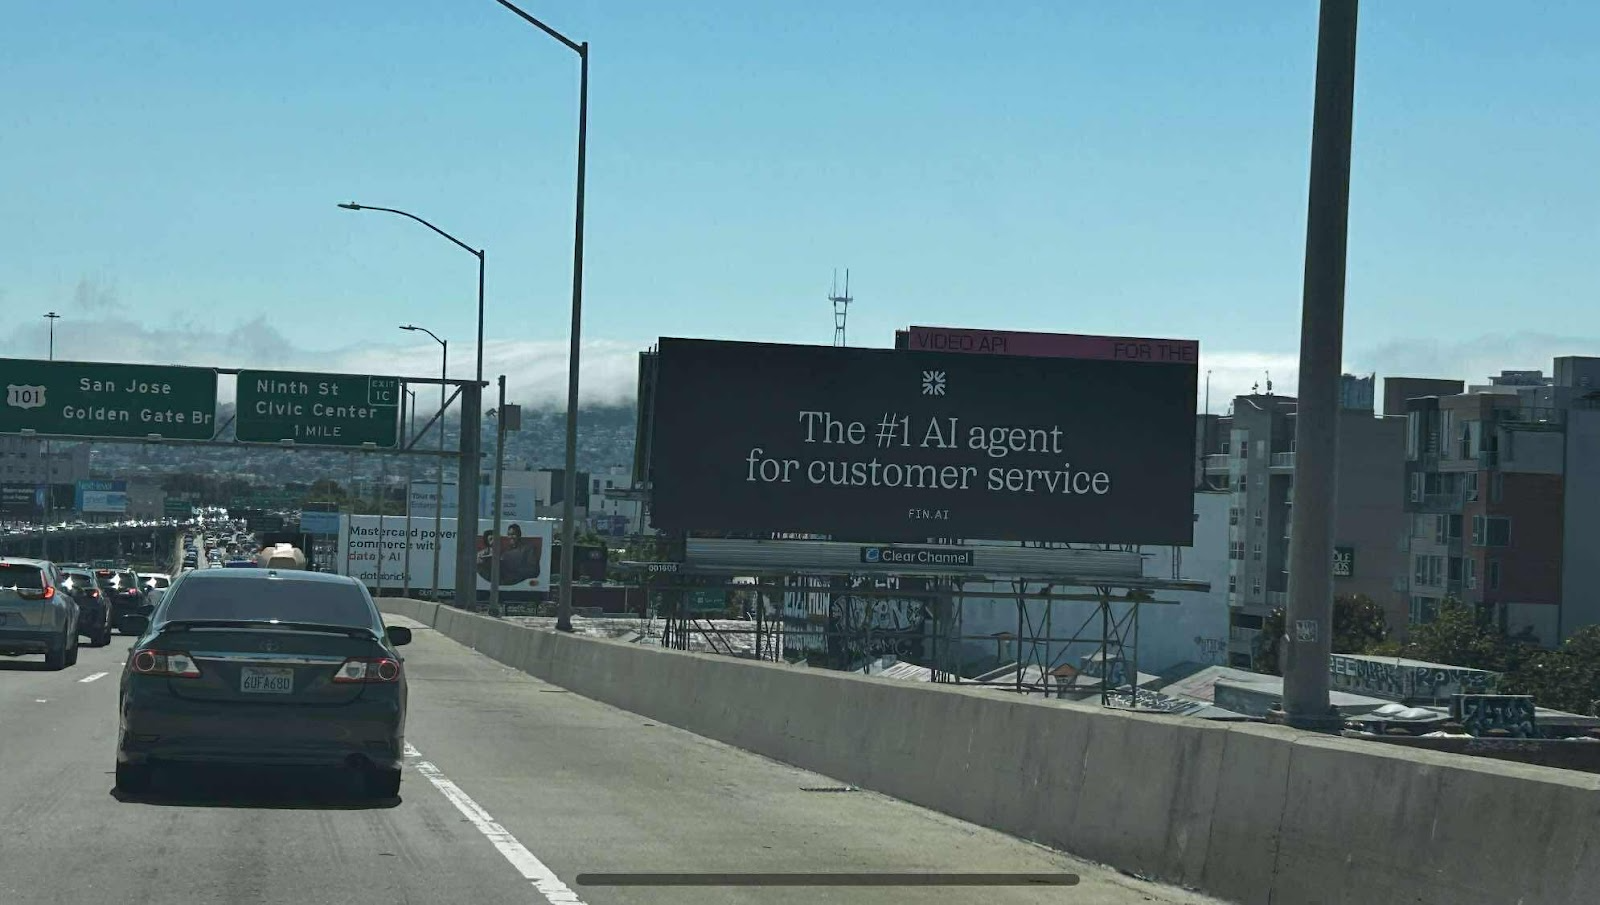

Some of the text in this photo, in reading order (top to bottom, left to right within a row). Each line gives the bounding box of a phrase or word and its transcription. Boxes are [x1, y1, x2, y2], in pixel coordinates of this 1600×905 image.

[917, 332, 1007, 353] VIDEO API
[1113, 342, 1194, 361] FOR THE
[79, 377, 172, 394] San Jose
[256, 379, 339, 396] Ninth St
[372, 380, 396, 388] EXIT
[14, 390, 40, 404] 101
[376, 391, 391, 401] 1C
[63, 405, 212, 425] Golden Gate Br
[255, 401, 378, 419] Civic Center
[293, 424, 342, 437] 1 MILE
[798, 410, 1064, 458] The #1 AI agent
[745, 448, 1111, 495] for customer service
[907, 507, 951, 521] FIN.AI
[350, 525, 418, 538] Mastrcad
[416, 540, 441, 551] wit
[388, 551, 402, 562] AI
[882, 550, 970, 563] Clear Channel
[244, 676, 290, 690] 6UFA680
